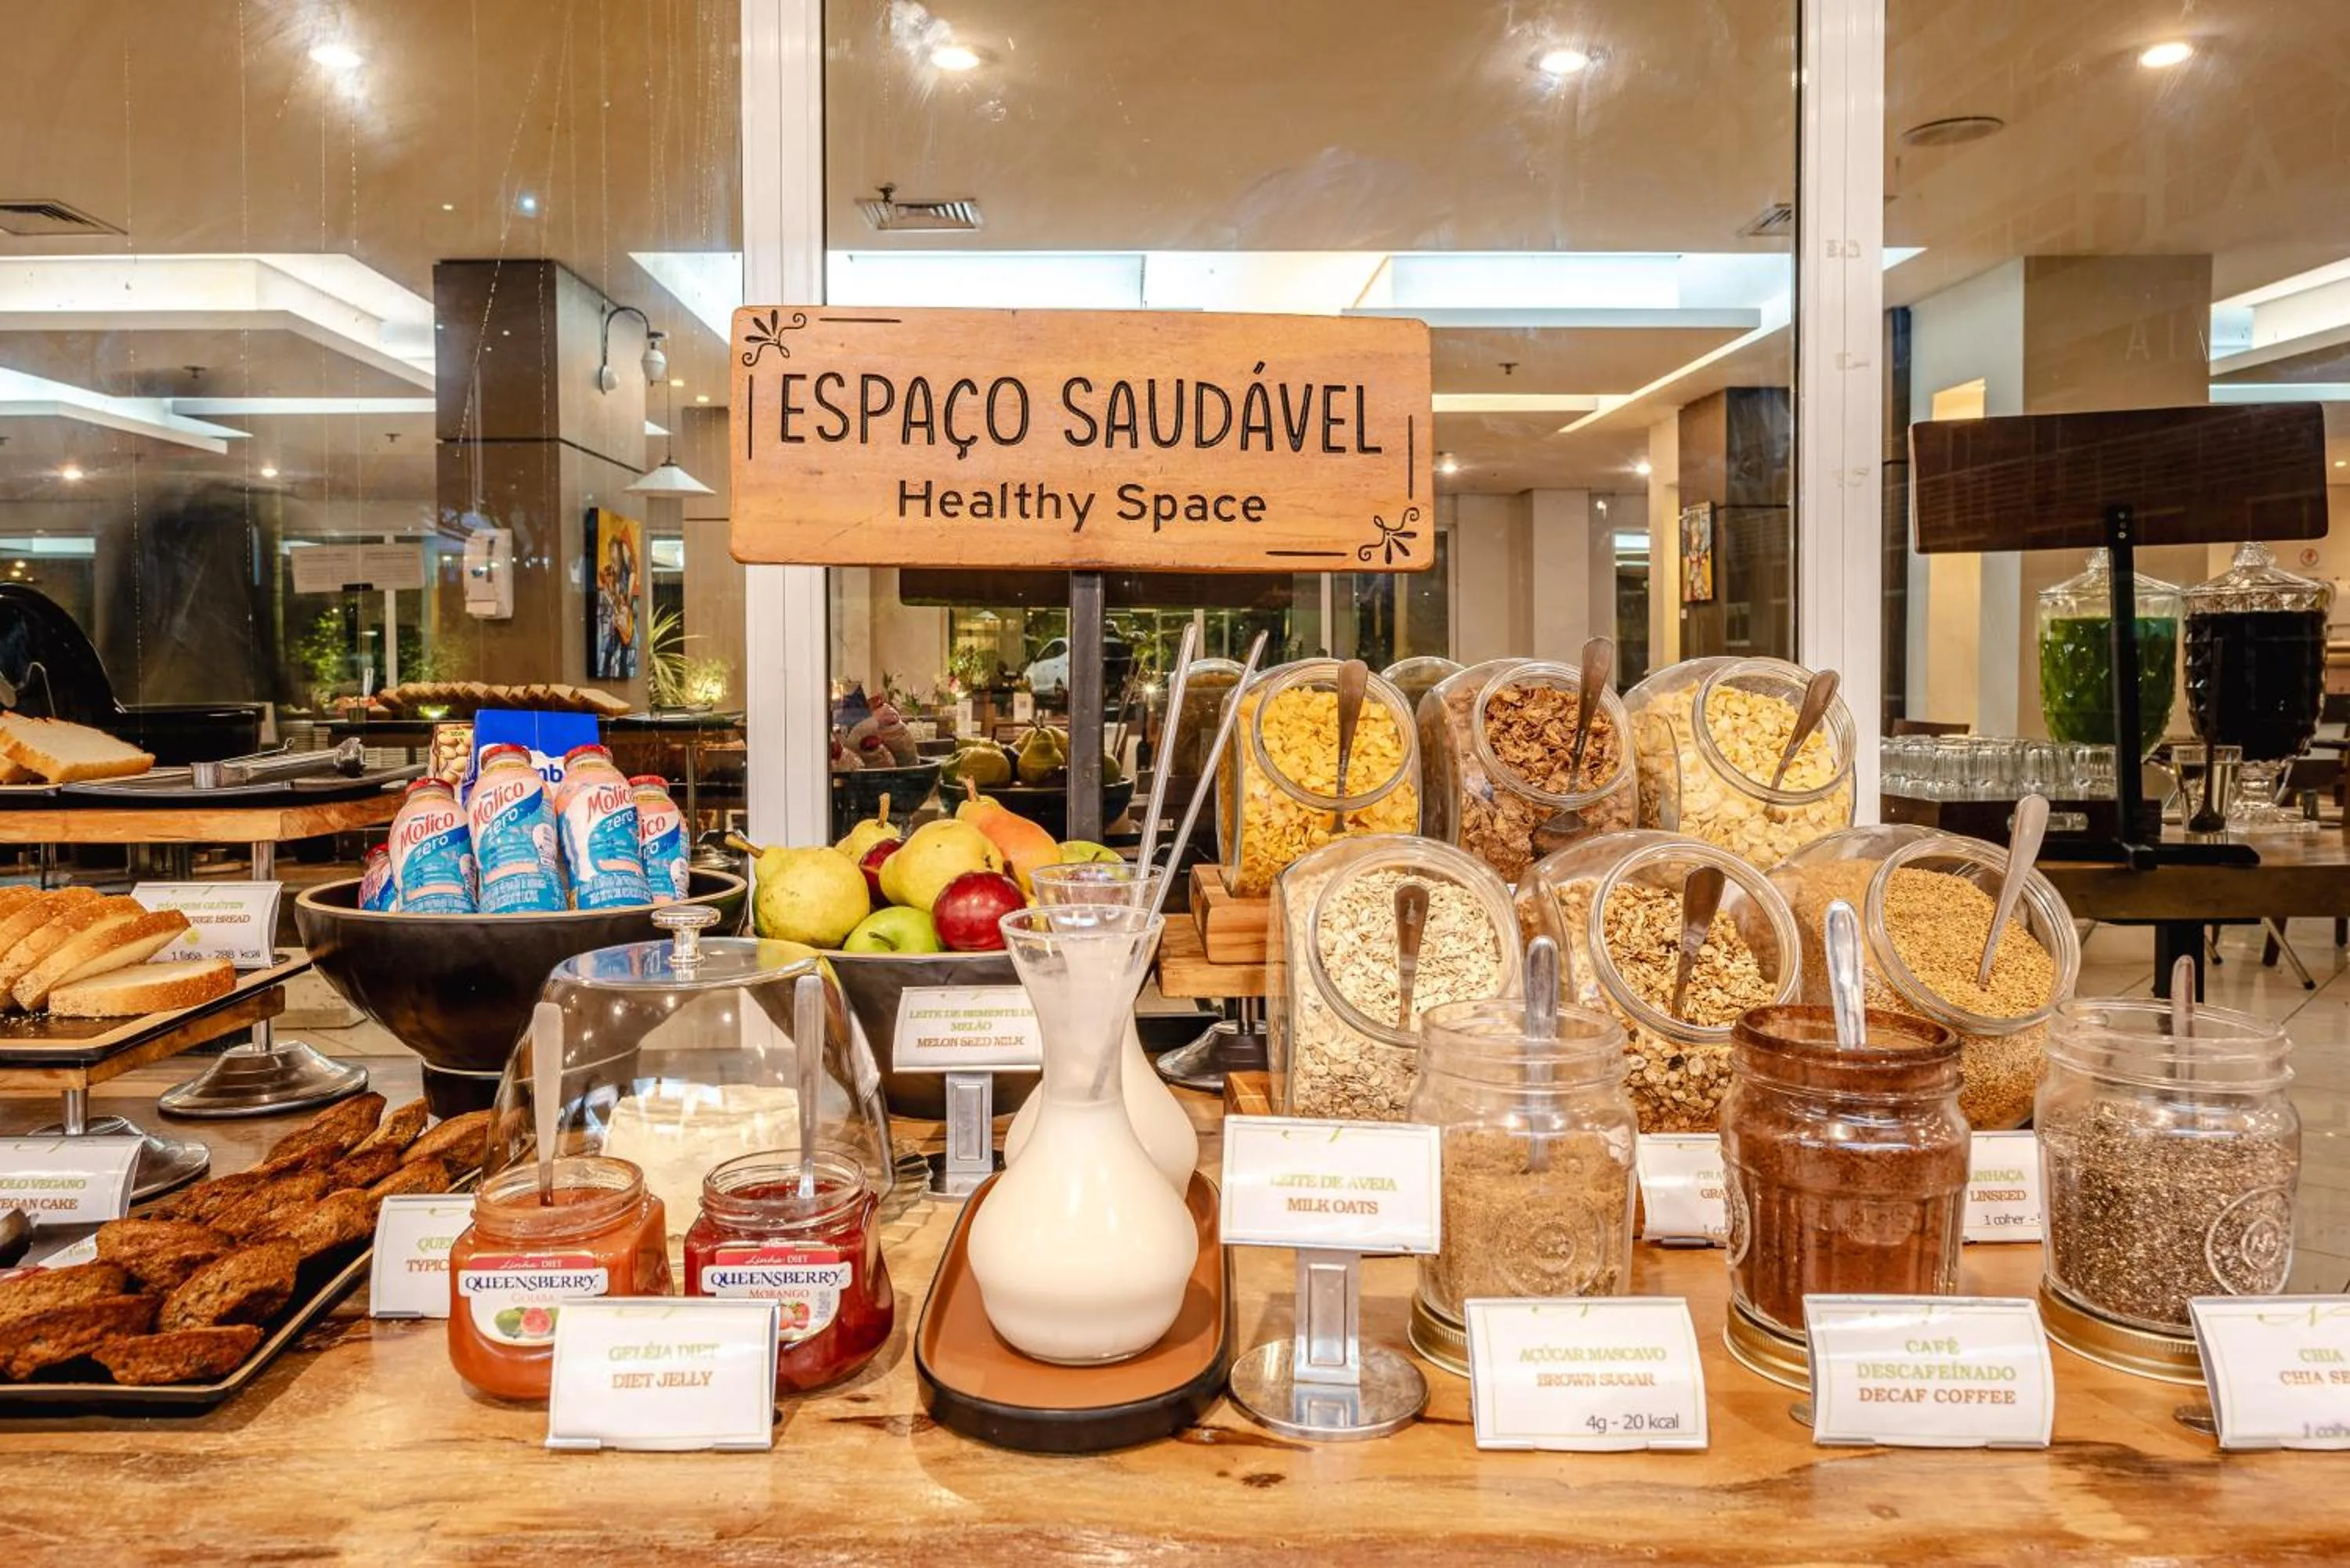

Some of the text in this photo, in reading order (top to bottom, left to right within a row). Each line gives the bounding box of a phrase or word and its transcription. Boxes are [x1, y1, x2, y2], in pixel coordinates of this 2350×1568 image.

[780, 360, 1383, 461] ESPAÇO SAUDÁVEL
[898, 479, 1267, 533] Healthy Space
[473, 782, 524, 832] Molico
[588, 785, 634, 824] Molico
[487, 807, 519, 840] zero
[606, 810, 634, 833] zero
[400, 812, 455, 854] Molico
[414, 834, 449, 862] zero
[215, 914, 251, 924] BREAD
[950, 1019, 992, 1031] MELÃO
[916, 1035, 1026, 1048] MELON SEED MILK
[31, 1178, 87, 1190] VEGANO
[1320, 1176, 1347, 1189] DE
[1348, 1176, 1398, 1191] AVEIA
[40, 1198, 78, 1210] CAKE
[1969, 1190, 2026, 1202] LINSEED
[1288, 1197, 1379, 1215] MILK OATS
[1983, 1215, 1990, 1226] 1
[540, 1259, 563, 1268] DIET
[786, 1255, 809, 1263] DIET
[465, 1274, 599, 1292] QUEENSBERRY
[710, 1269, 845, 1288] QUEENSBERRY
[748, 1288, 810, 1299] MORANGO
[1519, 1343, 1667, 1364] AÇÚCAR MASCAVO
[1905, 1336, 1961, 1356] CAFÉ
[2298, 1348, 2345, 1362] CHIA
[611, 1370, 714, 1389] DIET JELLY
[1536, 1372, 1657, 1387] BROWN SUGAR
[1857, 1360, 2017, 1382] DESCAFEÍNADO
[2280, 1370, 2324, 1386] CHIA
[1859, 1387, 2016, 1404] DECAF COFFEE
[1585, 1414, 1607, 1434] 4g
[1623, 1414, 1645, 1430] 20
[1648, 1412, 1679, 1430] kcal
